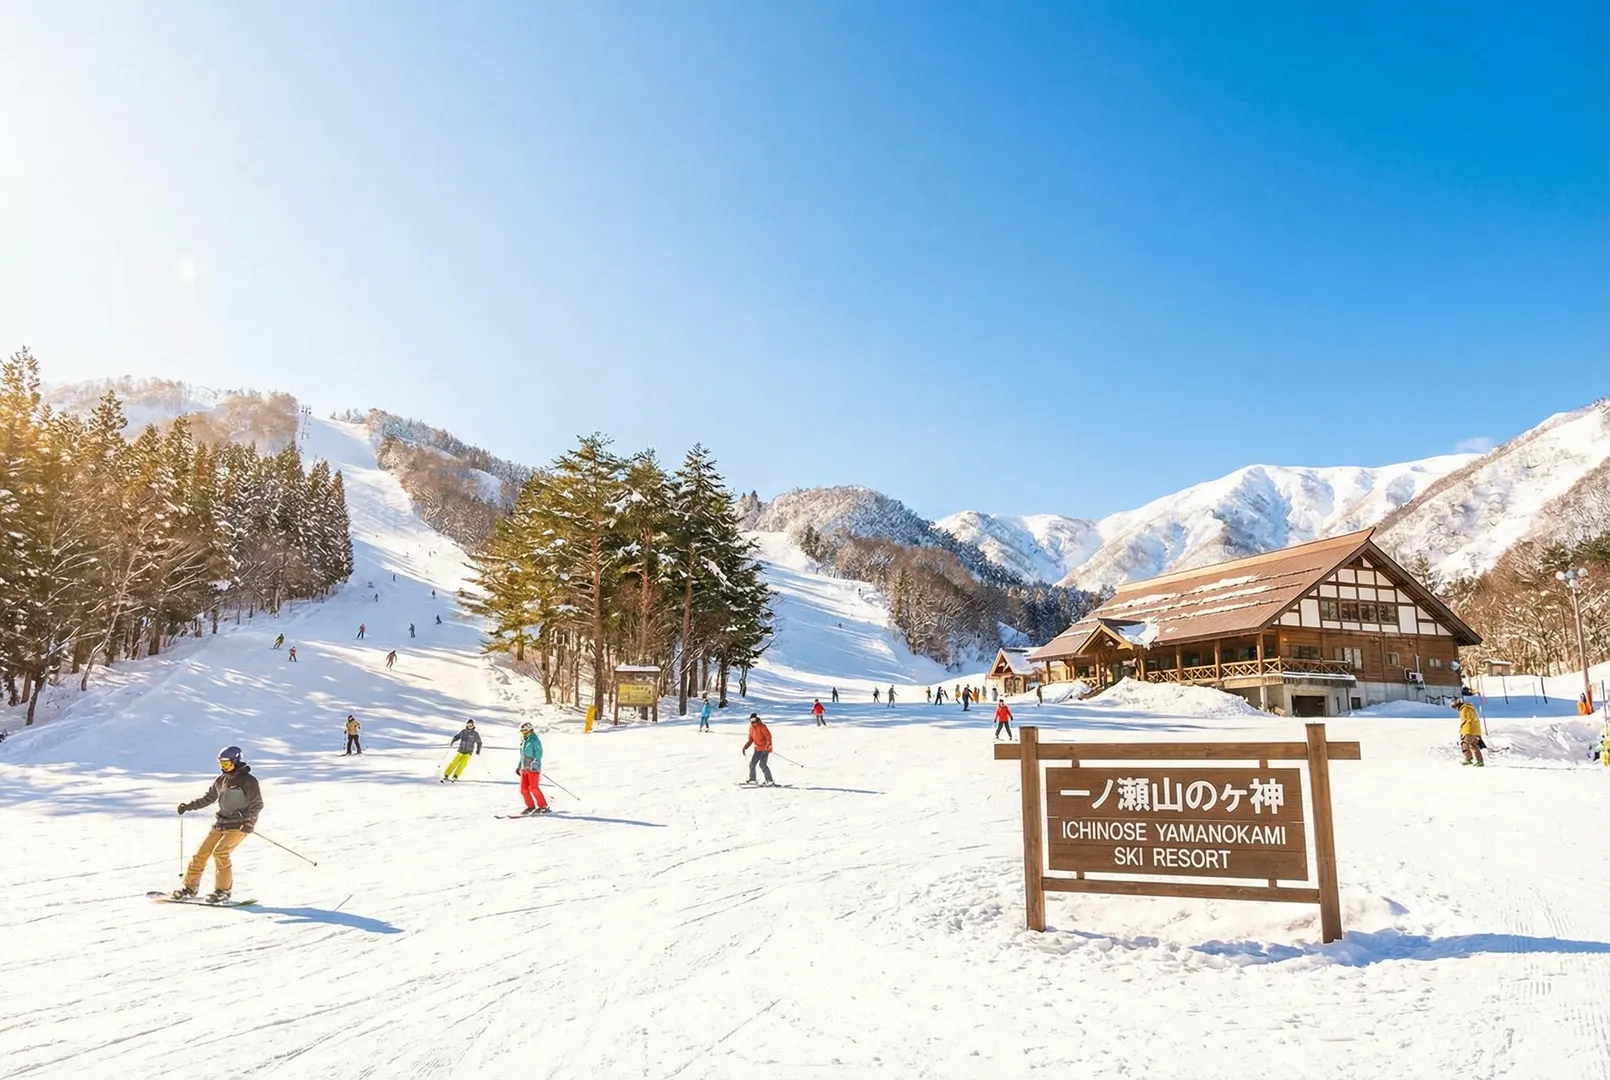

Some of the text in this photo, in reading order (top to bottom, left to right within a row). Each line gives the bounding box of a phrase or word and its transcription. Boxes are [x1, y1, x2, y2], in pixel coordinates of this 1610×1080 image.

[1062, 820, 1287, 845] ICHINOSE YAMANOKAMI
[1114, 846, 1231, 869] SKI RESORT
